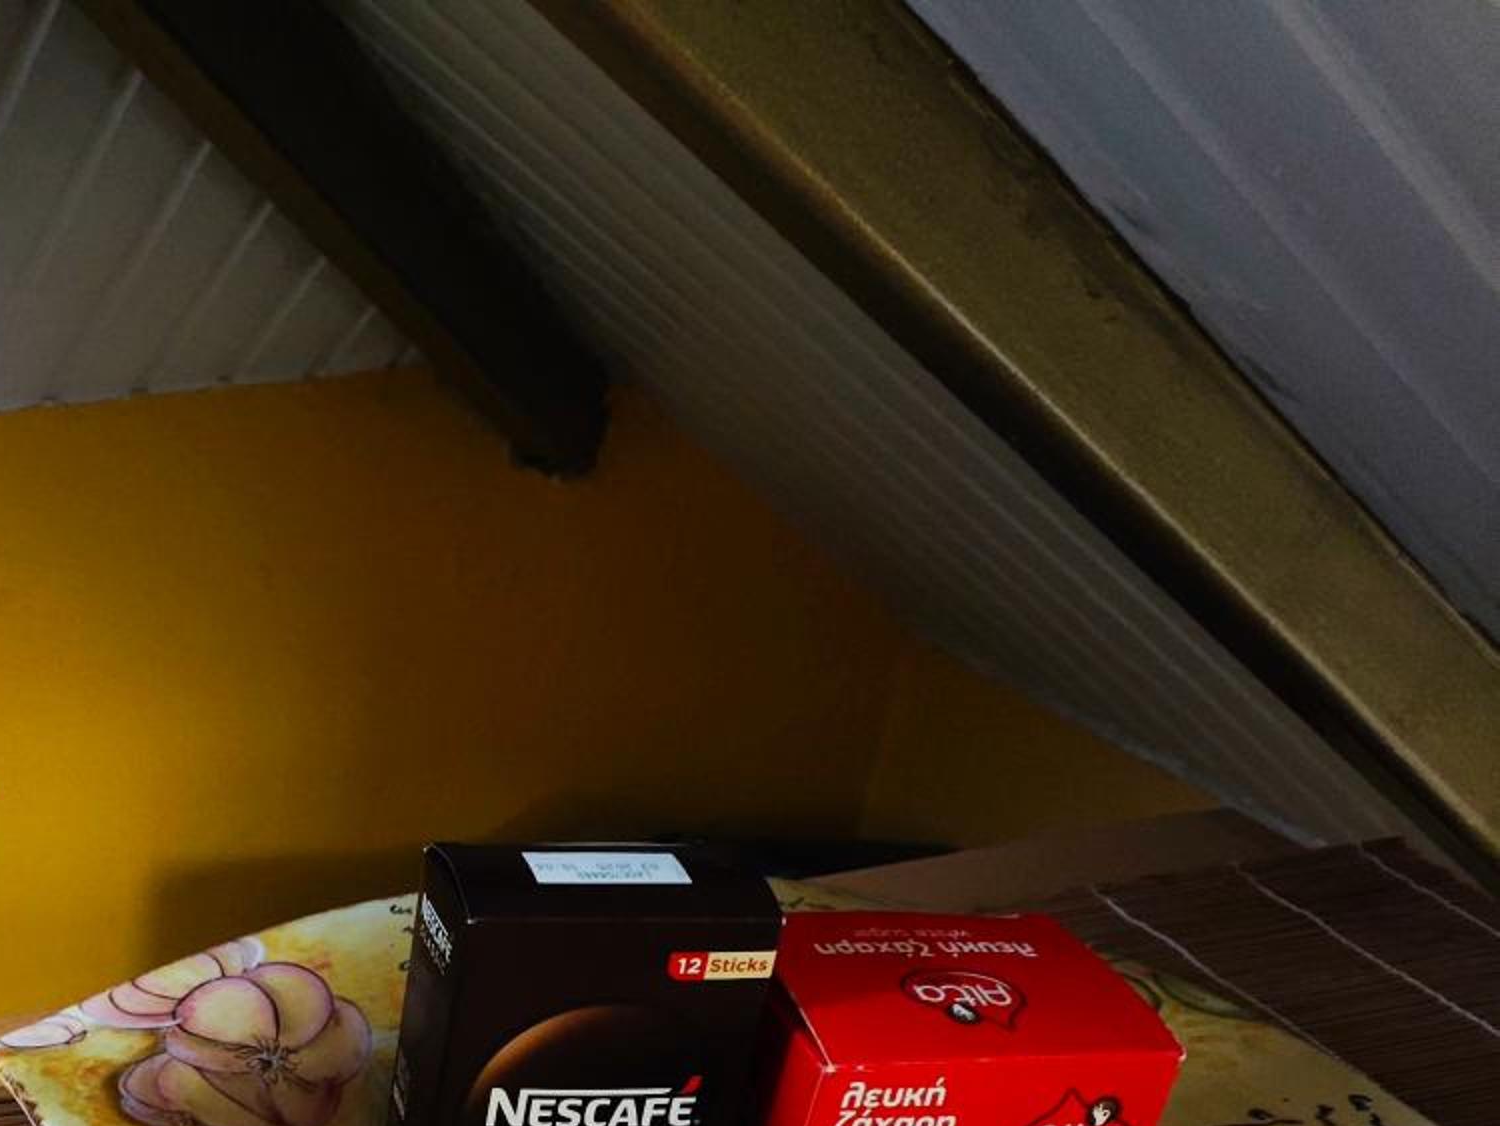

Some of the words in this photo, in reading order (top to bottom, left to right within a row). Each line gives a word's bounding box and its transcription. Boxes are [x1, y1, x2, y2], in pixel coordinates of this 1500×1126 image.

[677, 956, 702, 976] 12
[710, 955, 768, 975] Sticks
[914, 983, 1012, 1007] Alta
